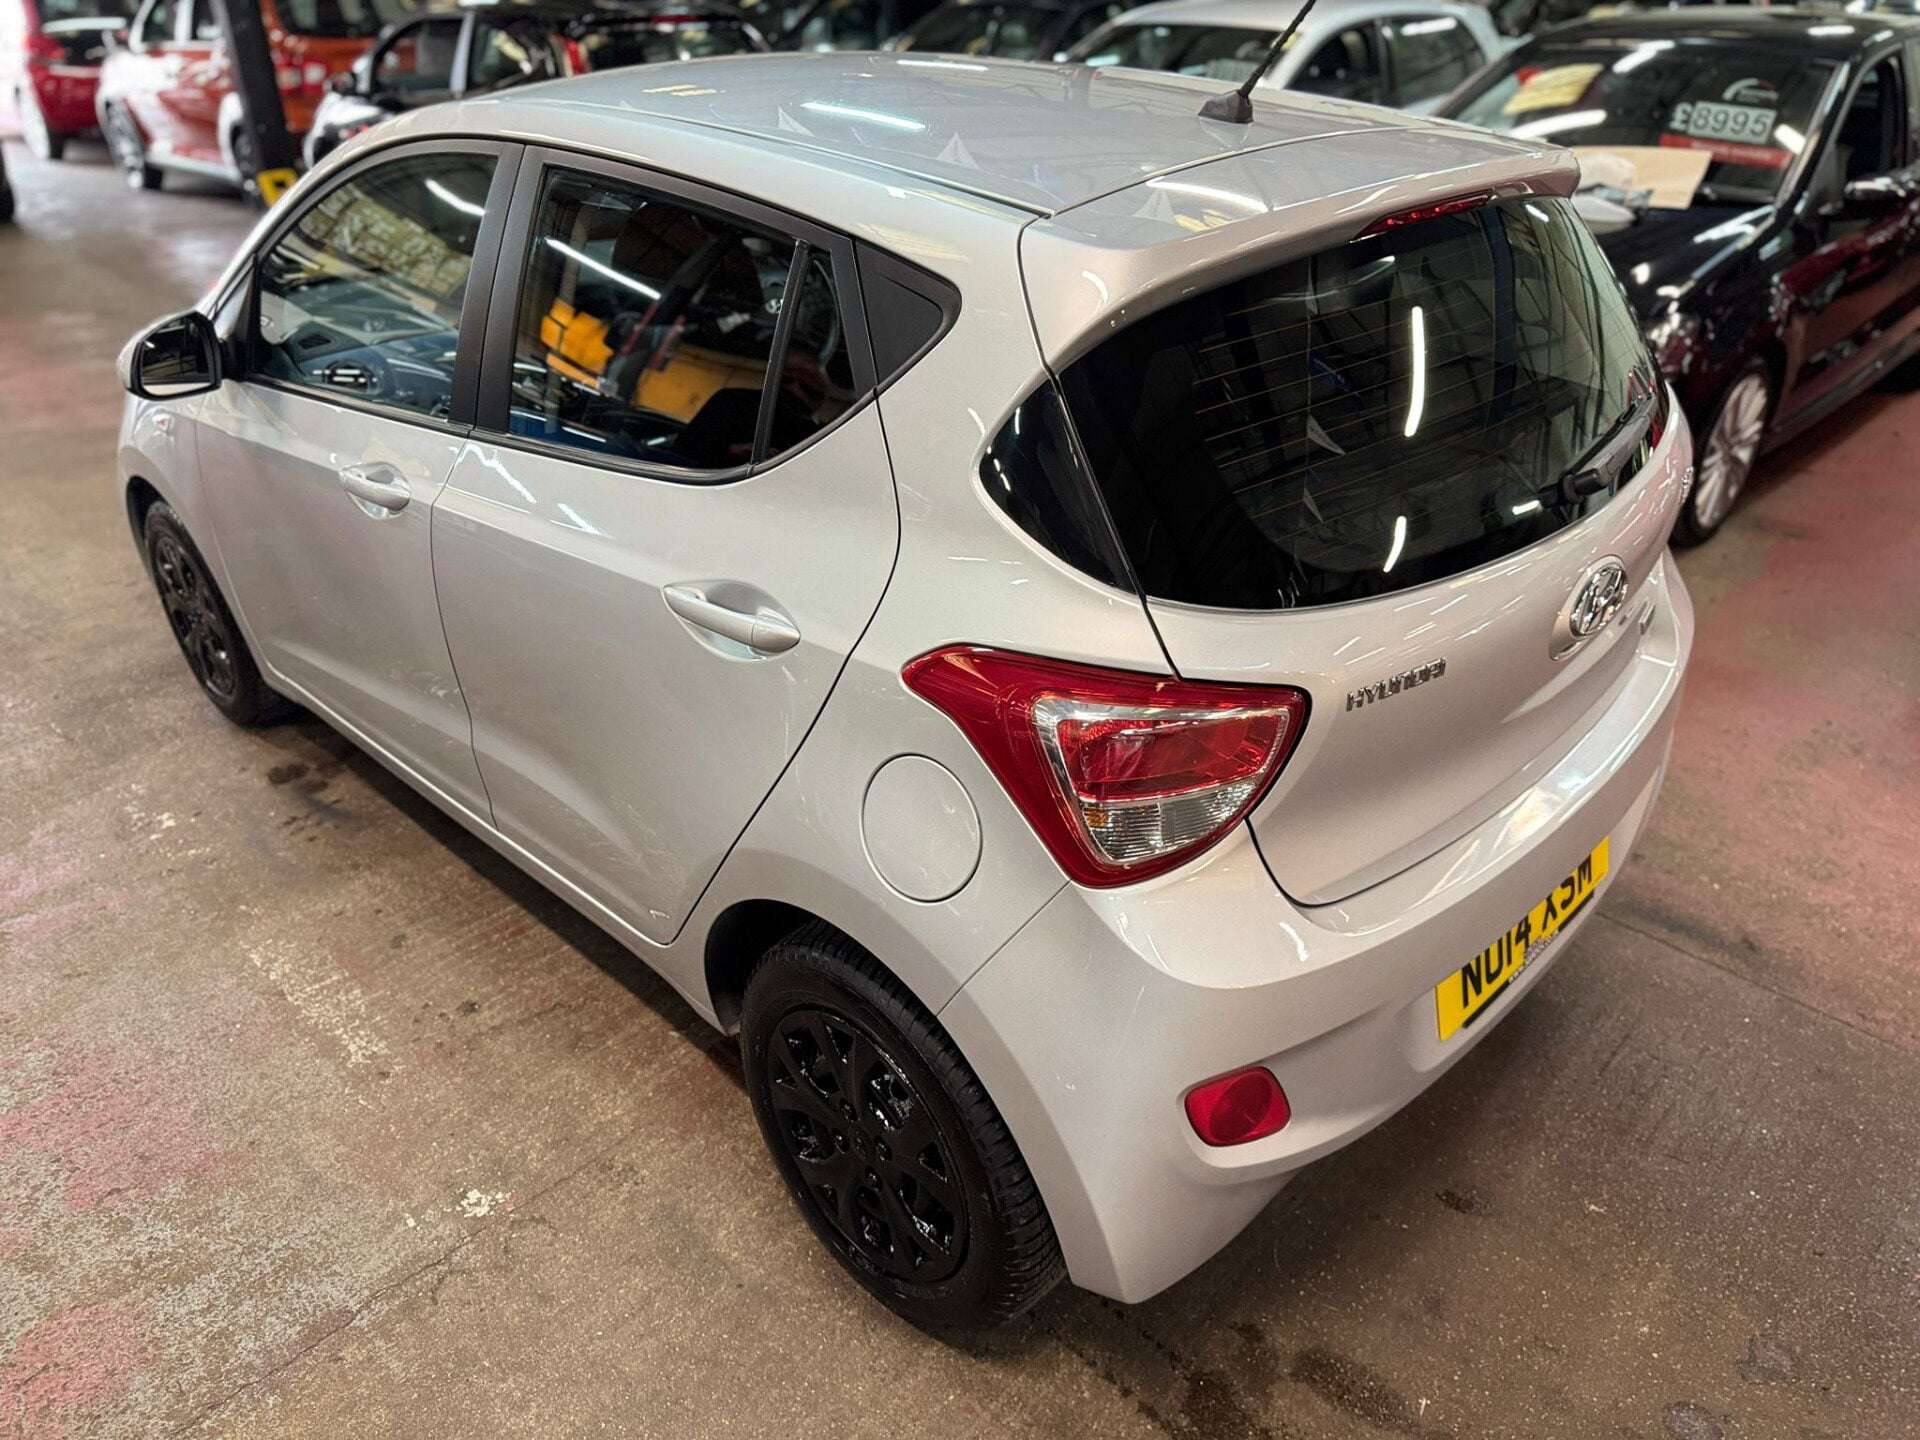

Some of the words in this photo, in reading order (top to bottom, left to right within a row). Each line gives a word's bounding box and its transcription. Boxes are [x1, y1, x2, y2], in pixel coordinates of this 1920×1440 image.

[1669, 102, 1769, 137] £8995
[1346, 656, 1446, 712] HYUNDAI
[1461, 913, 1532, 1009] NU14
[1542, 853, 1593, 932] XSM
